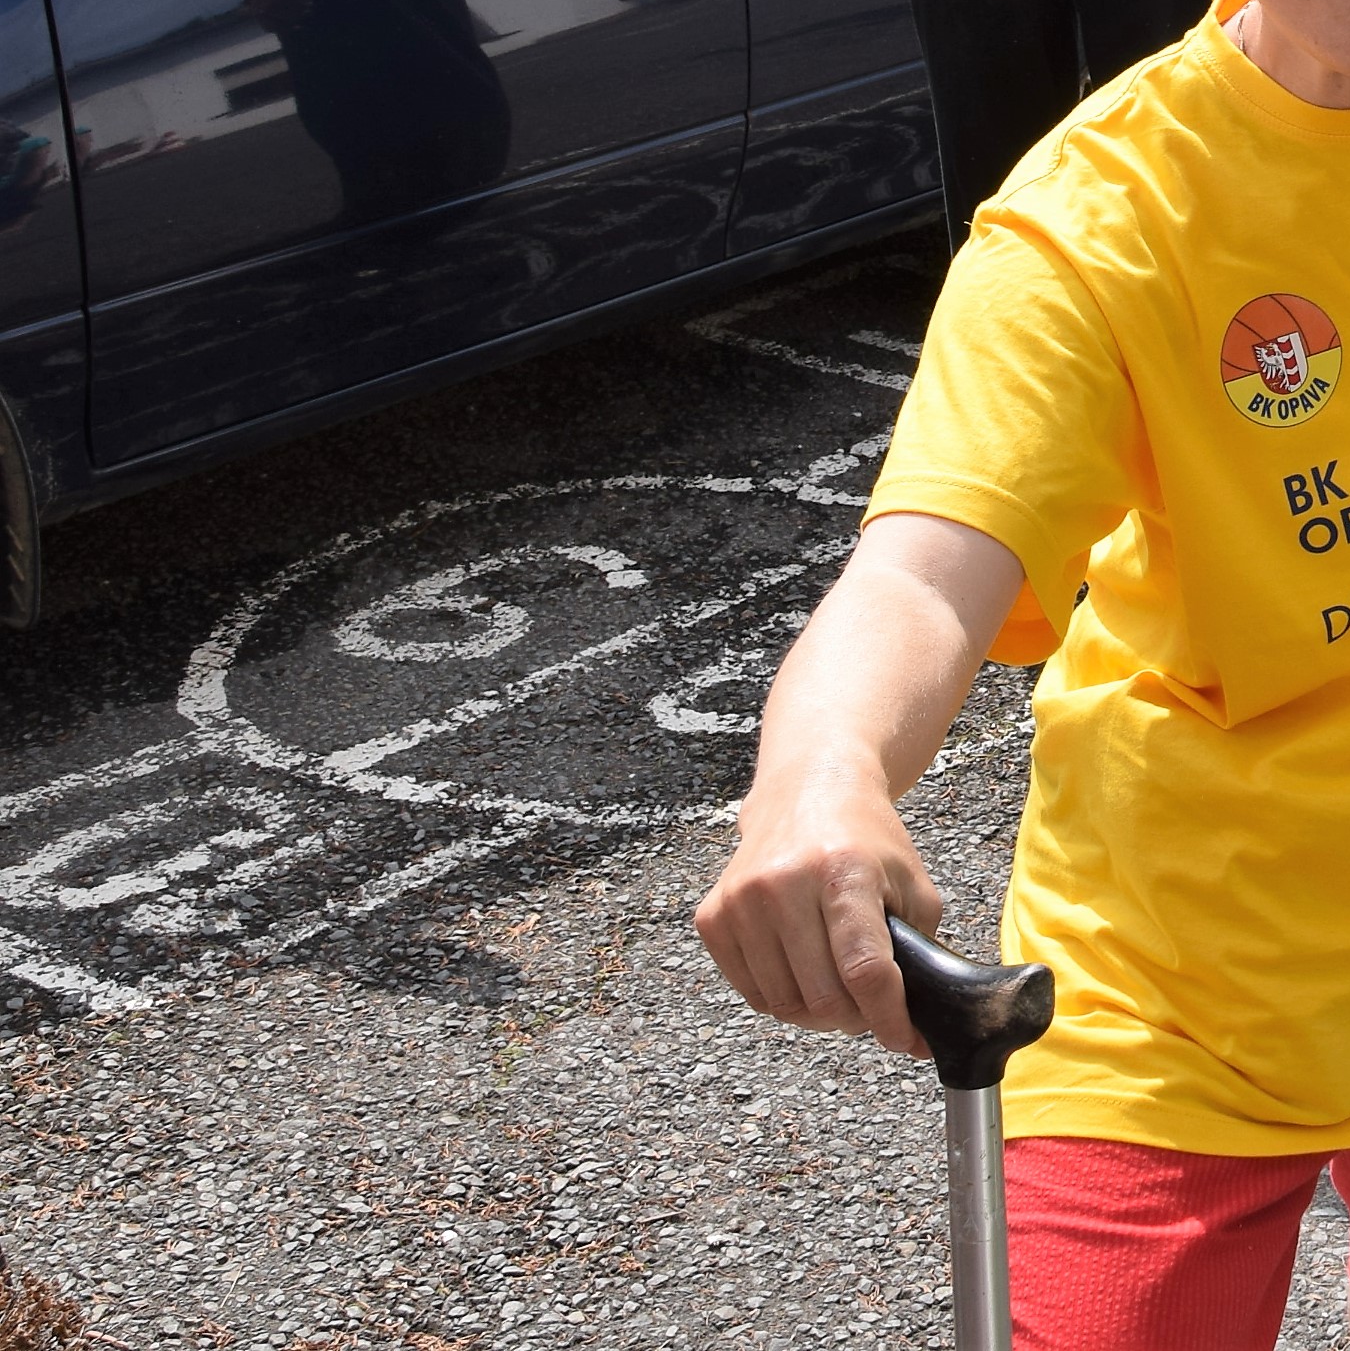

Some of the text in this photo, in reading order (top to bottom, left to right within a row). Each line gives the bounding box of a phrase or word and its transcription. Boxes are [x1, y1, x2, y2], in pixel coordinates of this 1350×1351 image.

[1247, 377, 1330, 421] BK OPAVA
[1283, 459, 1349, 516] BK
